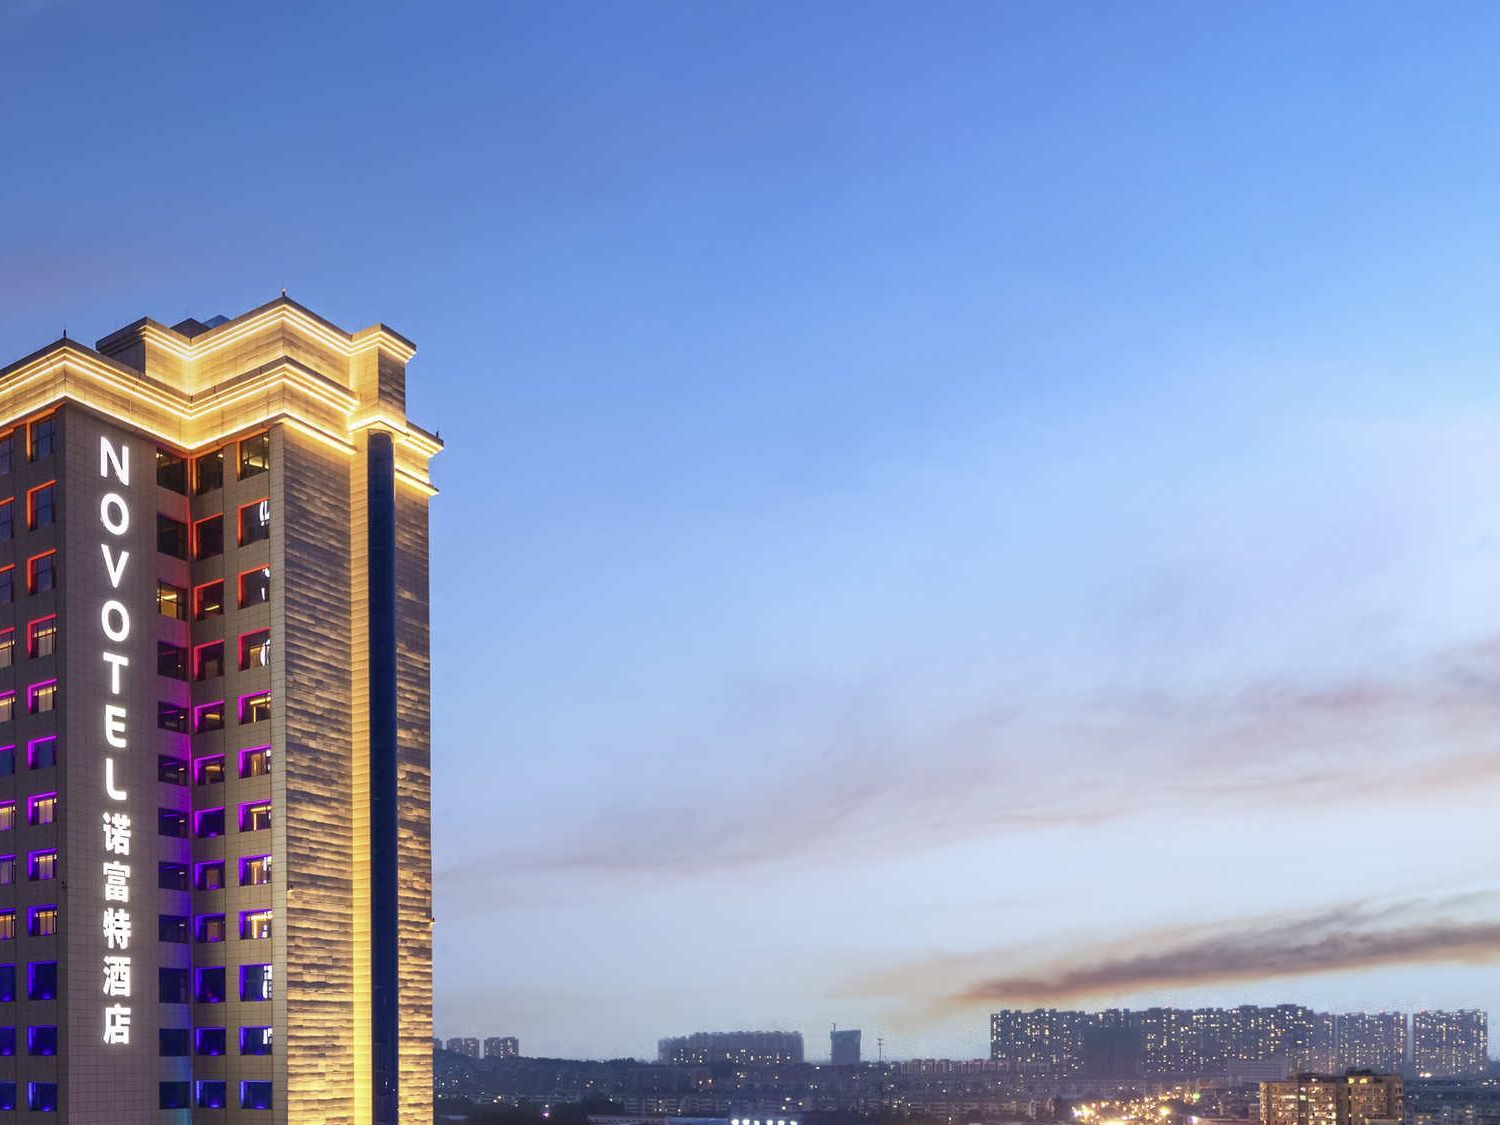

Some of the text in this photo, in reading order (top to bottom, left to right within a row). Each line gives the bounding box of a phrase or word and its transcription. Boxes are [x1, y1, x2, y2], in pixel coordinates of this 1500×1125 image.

[100, 436, 130, 801] NOVOTEL
[102, 811, 132, 1045] 诺富特酒店
